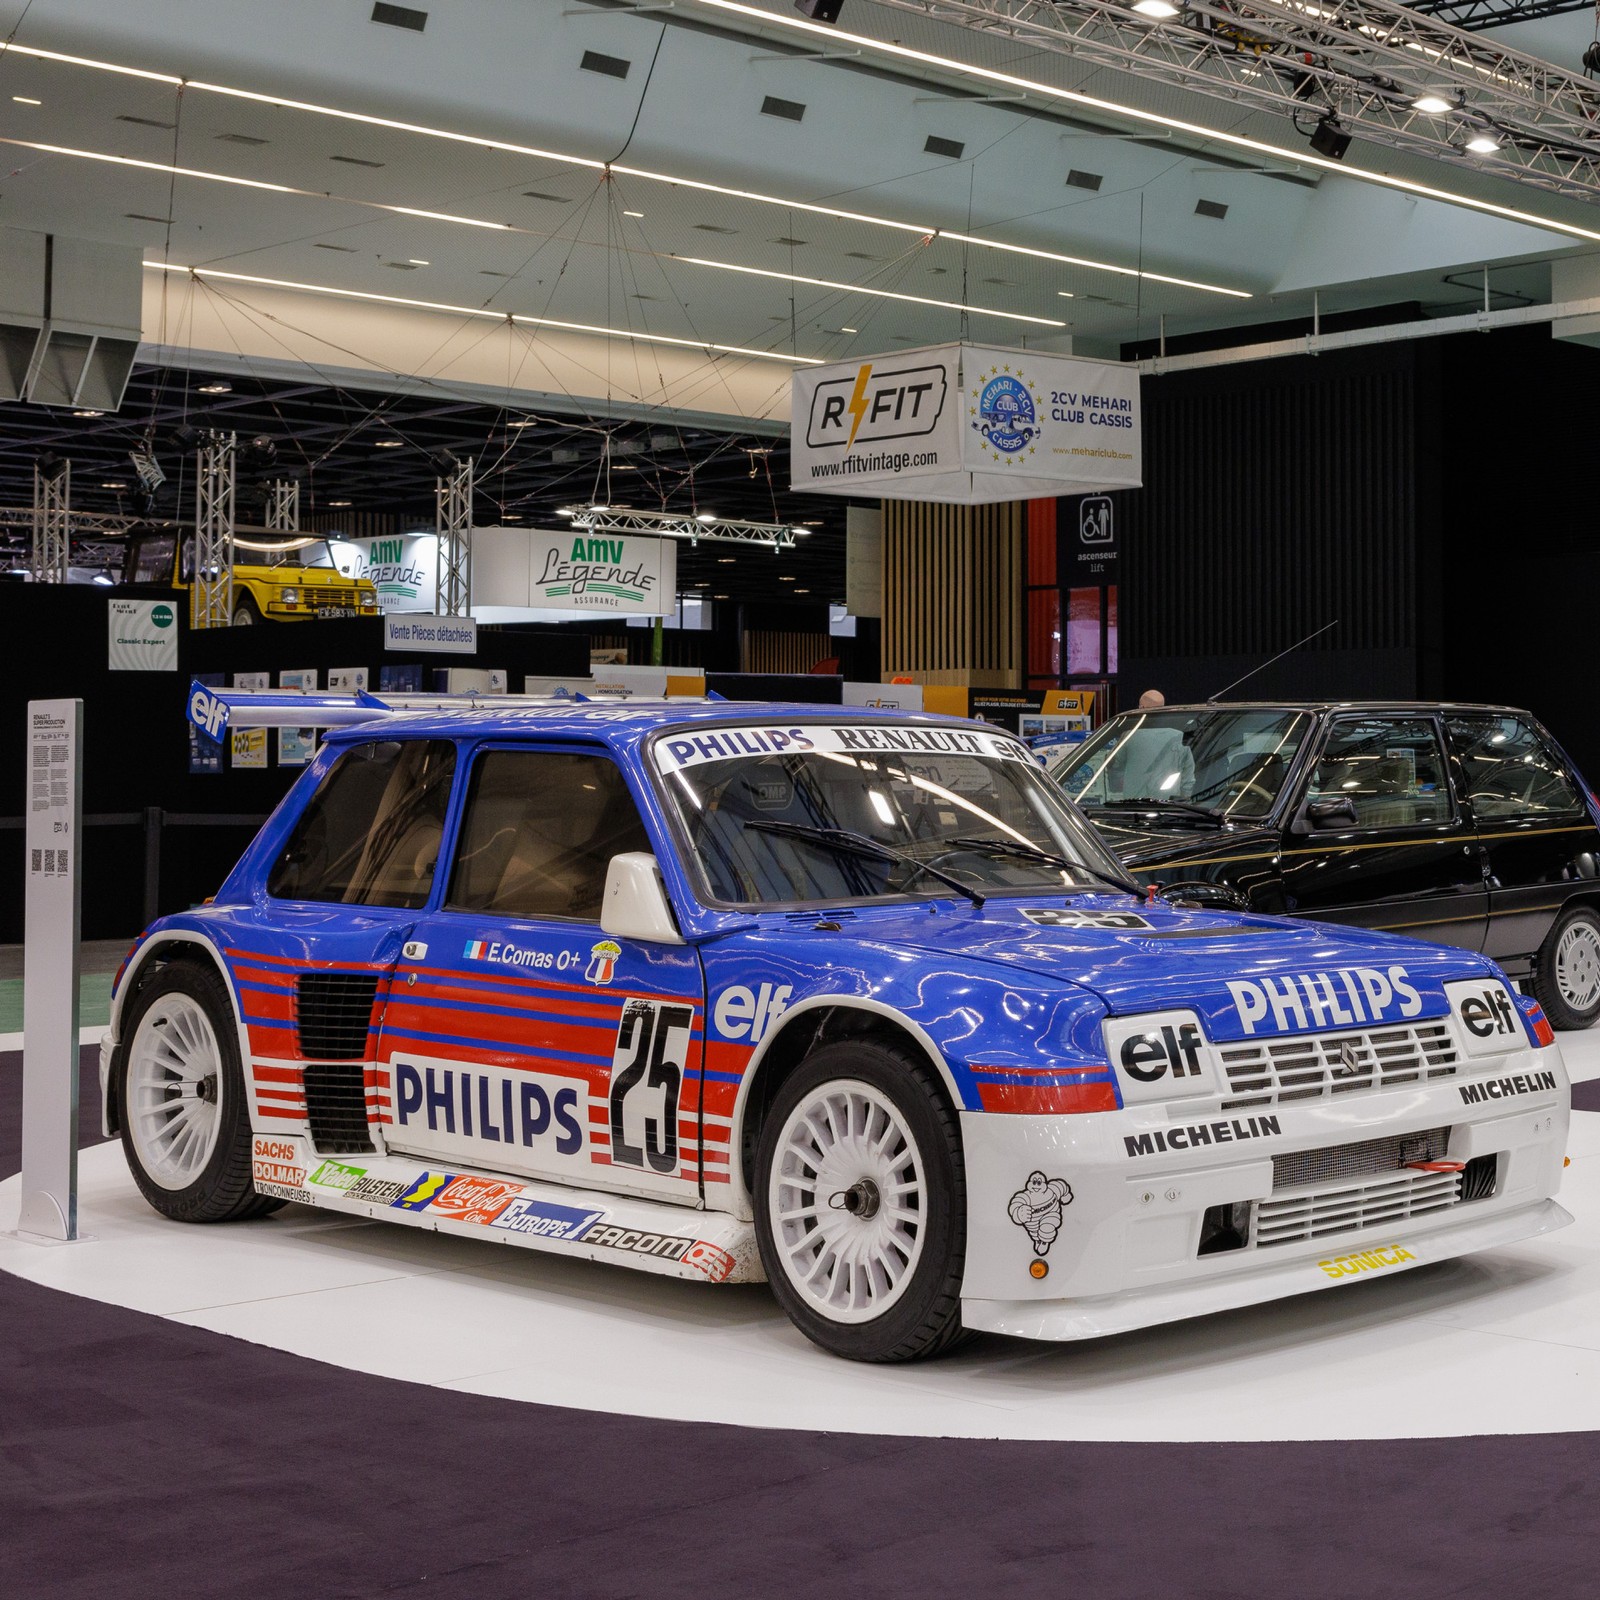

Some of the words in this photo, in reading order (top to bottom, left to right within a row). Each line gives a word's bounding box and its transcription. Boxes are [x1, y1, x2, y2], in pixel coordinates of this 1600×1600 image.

[983, 381, 1013, 409] MEHARI
[1018, 390, 1032, 415] 2CV
[997, 401, 1018, 411] CLUB
[1051, 391, 1077, 405] 2CV
[1082, 395, 1131, 412] MEHARI
[1052, 409, 1084, 423] CLUB
[1090, 413, 1132, 428] CASSIS
[992, 433, 1022, 449] CASSIS
[1052, 447, 1133, 459] www.mehariclub.com
[811, 451, 938, 478] www.rfitvintage.com
[1078, 552, 1117, 561] ascenseur
[1090, 563, 1104, 573] lift
[574, 597, 619, 607] ASSURANCE
[389, 623, 411, 639] Vente
[412, 625, 435, 641] Pièces
[437, 626, 473, 643] détachées
[191, 691, 227, 737] elf
[666, 728, 815, 767] PHILIPS
[831, 728, 985, 755] RENAULT
[991, 740, 1030, 763] elf
[759, 786, 787, 799] OMP
[1024, 909, 1149, 929] 25
[488, 942, 553, 969] E.Comas
[714, 982, 793, 1042] elf
[1226, 965, 1423, 1035] PHILIPS
[1460, 988, 1517, 1039] elf
[1120, 1022, 1203, 1083] elf
[609, 999, 693, 1174] 25
[1459, 1071, 1557, 1106] MICHELIN
[396, 1062, 584, 1156] PHILIPS
[1124, 1115, 1282, 1158] MICHELIN
[254, 1140, 294, 1161] SACHS
[254, 1162, 305, 1186] DOLMAR
[316, 1163, 361, 1189] Valeo
[352, 1177, 411, 1199] BILSTEIN
[255, 1181, 311, 1204] TRONCONNEUSES
[464, 1210, 488, 1224] Coke
[580, 1225, 693, 1260] FACOM
[1319, 1245, 1417, 1279] SONICA
